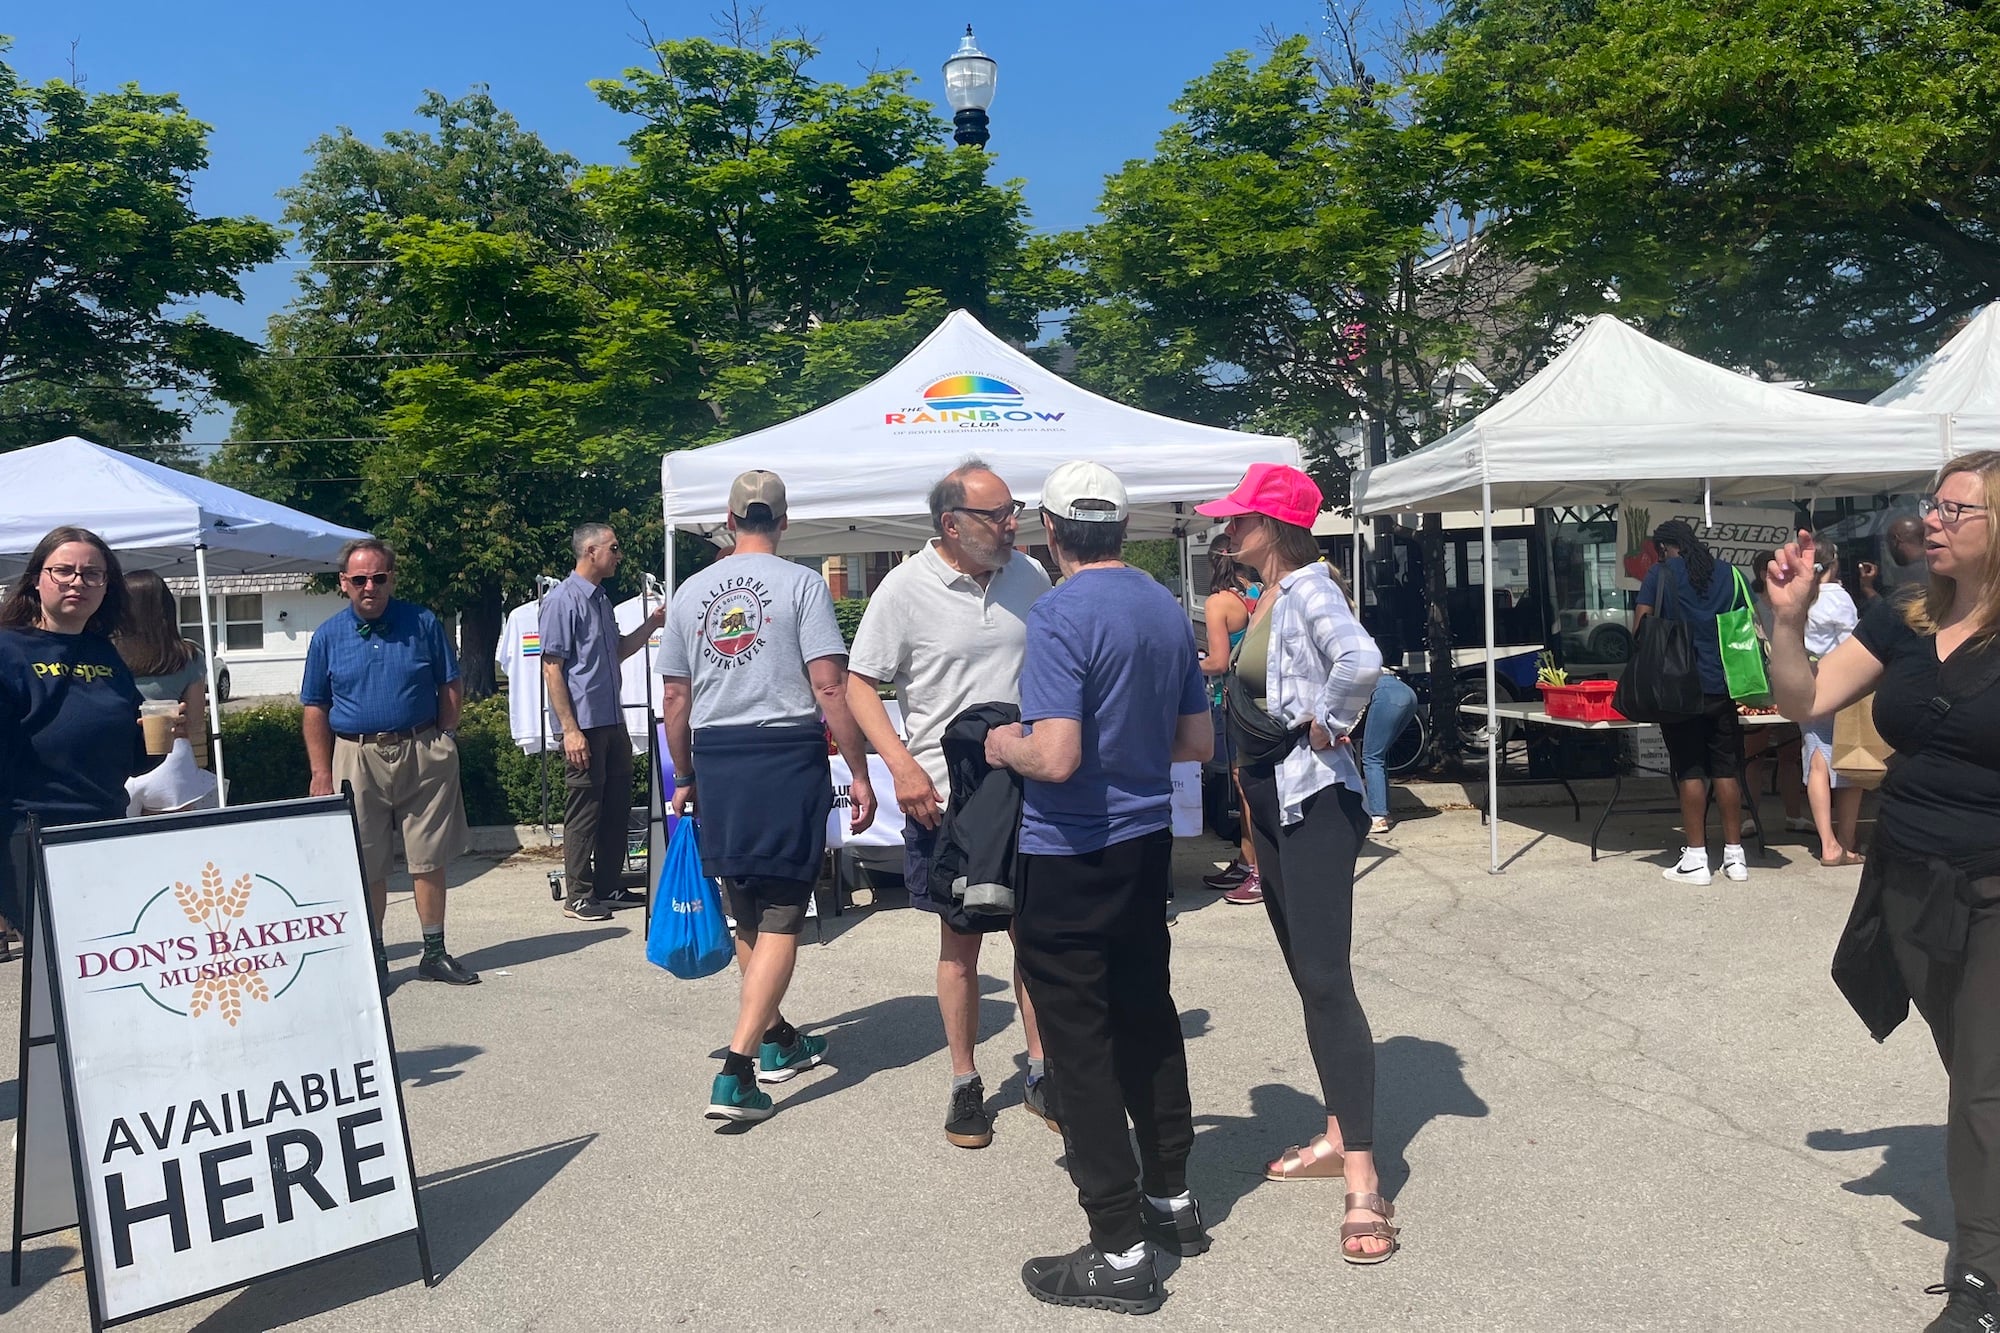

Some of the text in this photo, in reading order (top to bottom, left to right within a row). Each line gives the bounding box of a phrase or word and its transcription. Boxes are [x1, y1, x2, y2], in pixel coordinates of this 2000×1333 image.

[885, 409, 1065, 425] RAINBOW
[1703, 543, 1760, 567] ARM
[697, 576, 772, 620] CALIFORNIA
[703, 638, 766, 670] QUIKILVER
[75, 911, 349, 979] DON'S BAKERY
[159, 951, 288, 989] MUSKOKA
[102, 1059, 379, 1164] AVAILABLE
[104, 1107, 396, 1269] HERE
